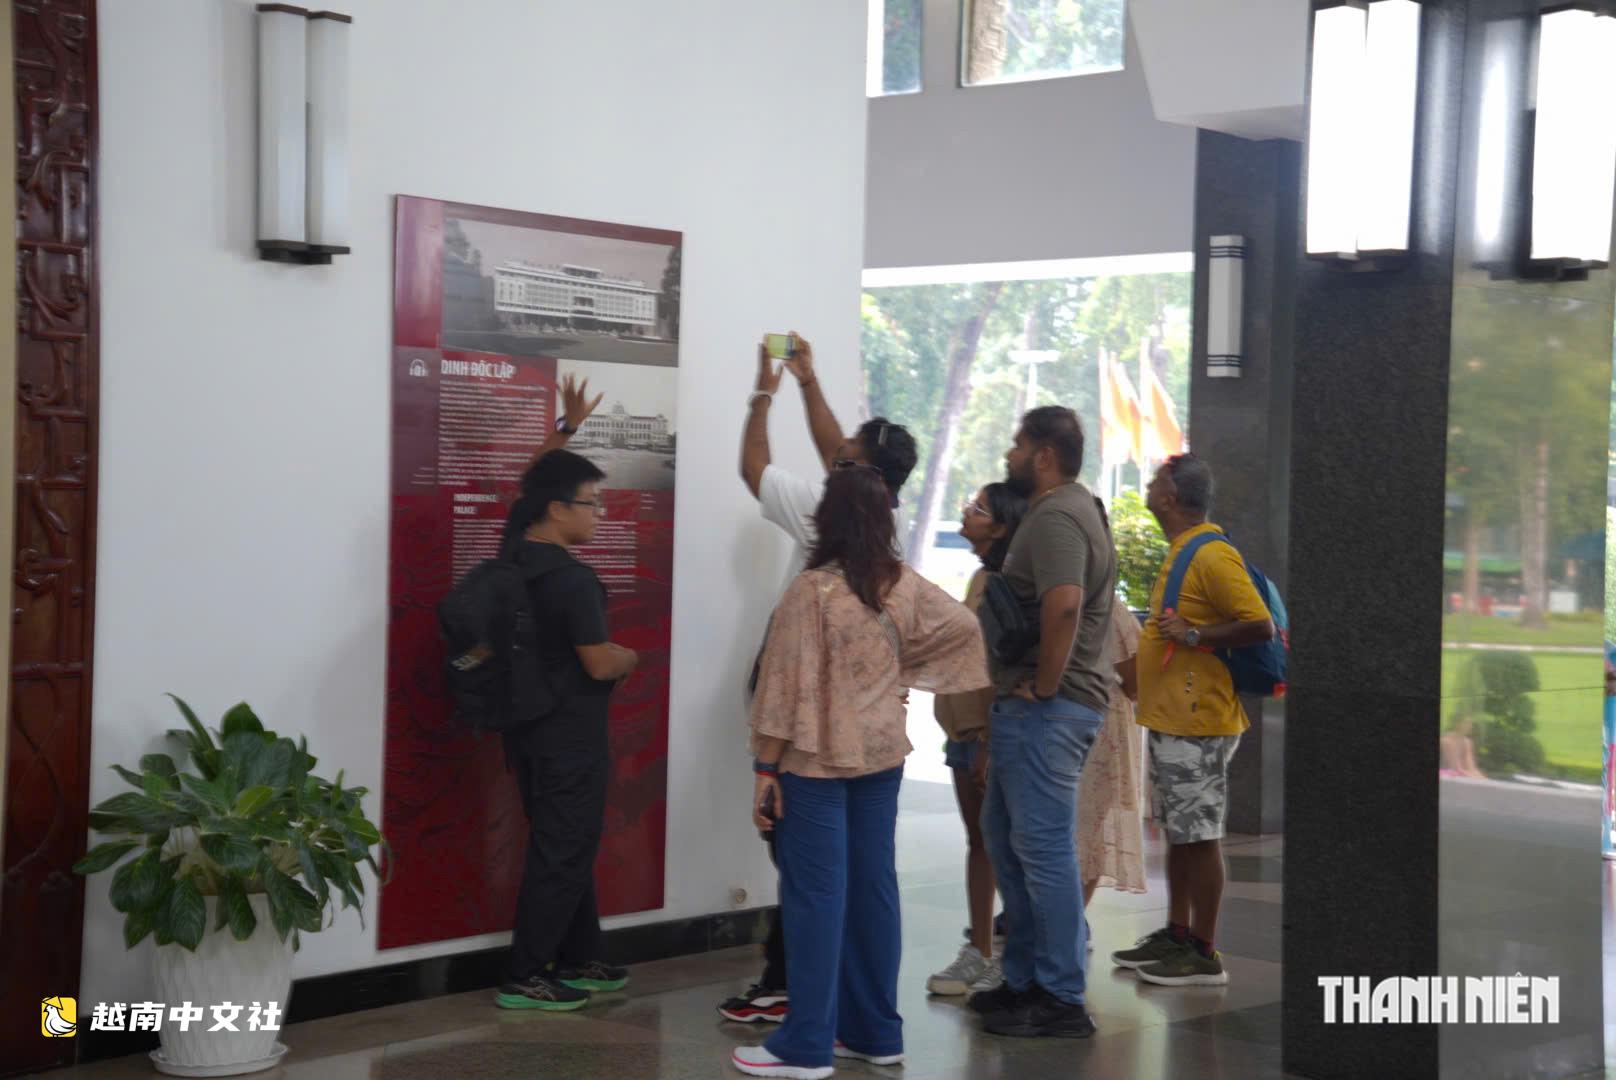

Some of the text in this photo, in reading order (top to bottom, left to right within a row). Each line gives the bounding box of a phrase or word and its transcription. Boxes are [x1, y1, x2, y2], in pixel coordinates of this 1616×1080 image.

[441, 359, 516, 382] DINH ĐỘC LẬP
